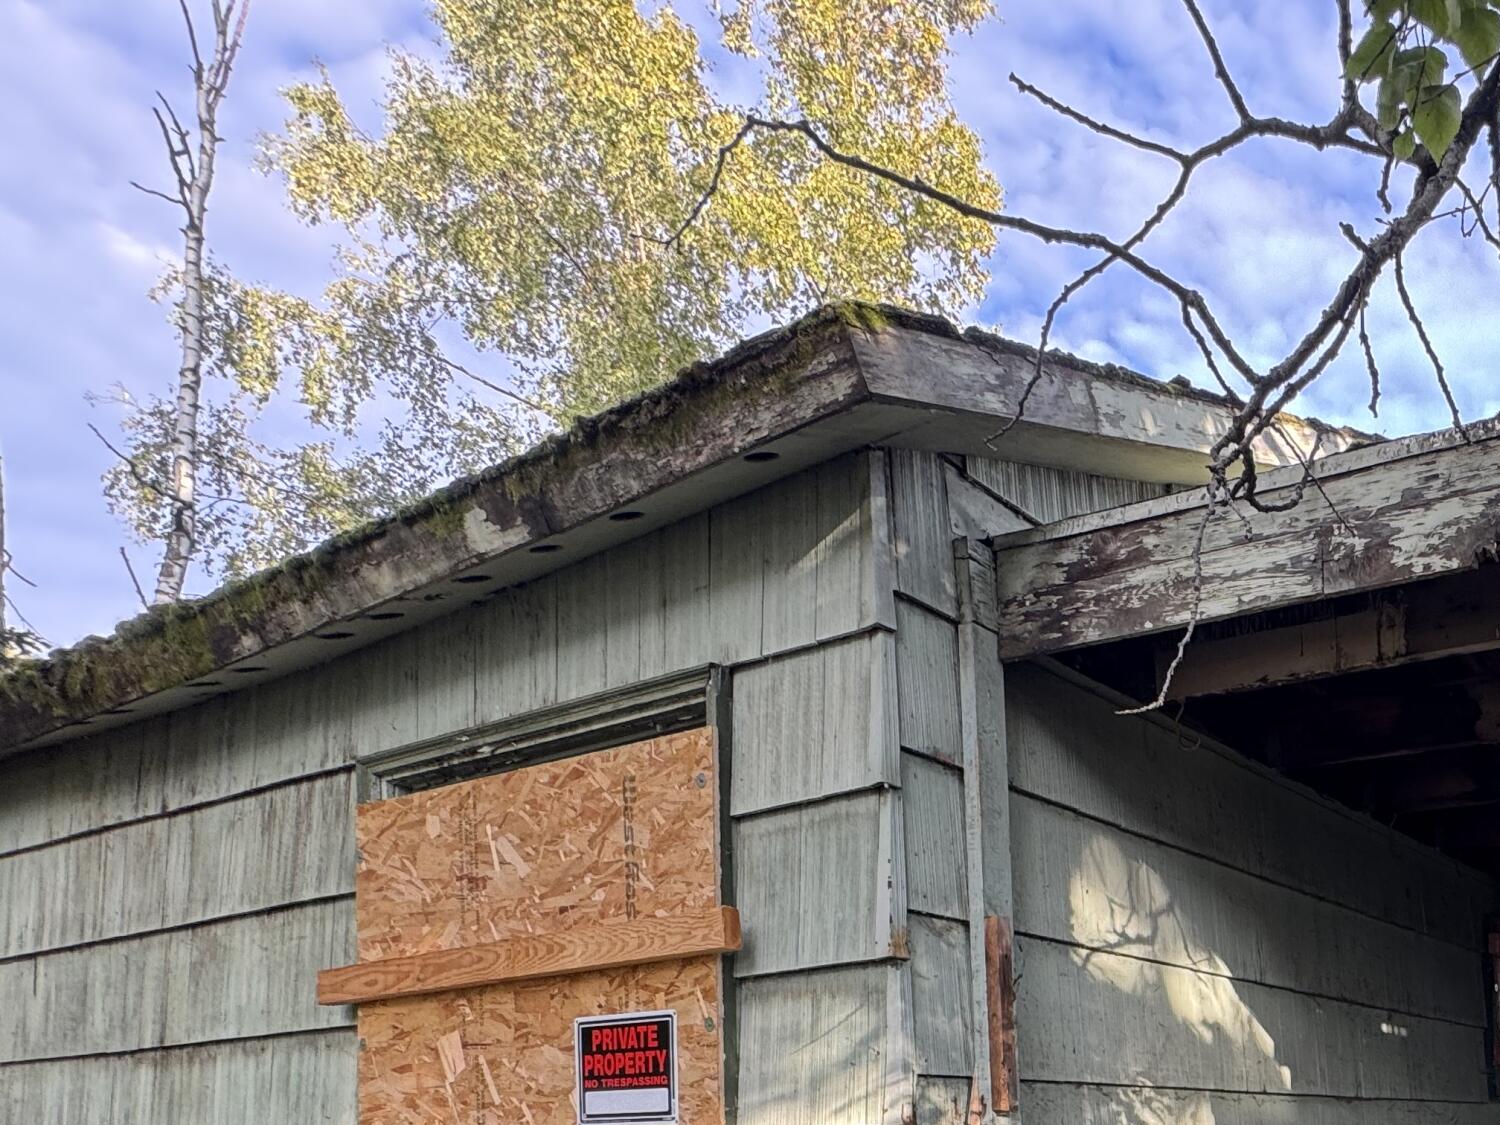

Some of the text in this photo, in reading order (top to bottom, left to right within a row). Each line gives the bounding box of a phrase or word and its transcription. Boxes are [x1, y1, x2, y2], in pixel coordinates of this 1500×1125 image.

[623, 774, 640, 920] West Fras
[591, 1025, 659, 1052] PRIVATE
[584, 1049, 667, 1077] PROPERTY
[584, 1075, 668, 1088] NO TRESPASSING
